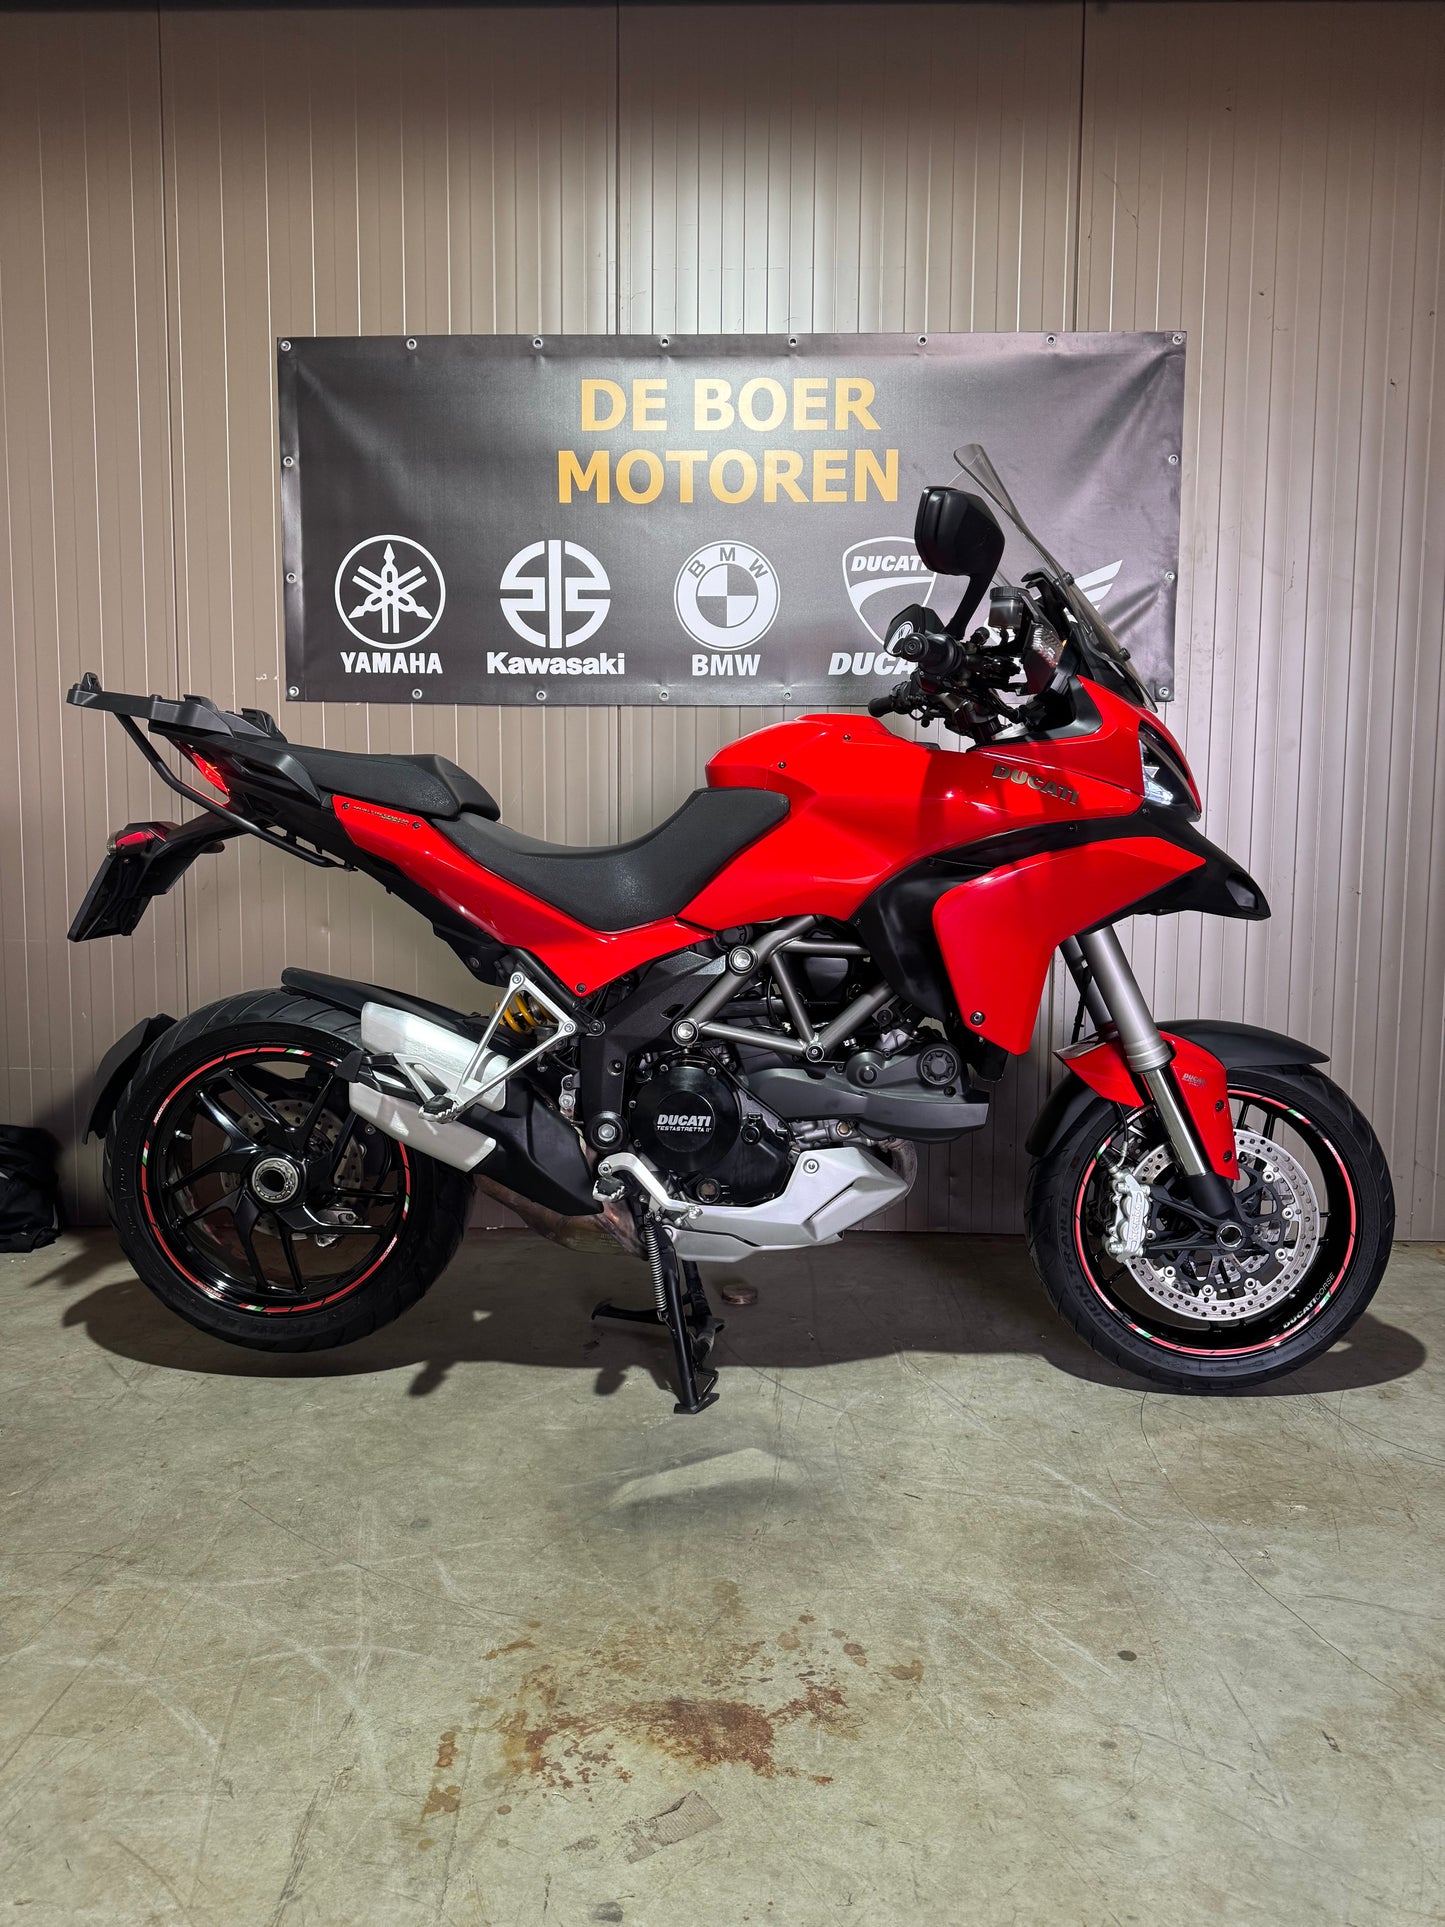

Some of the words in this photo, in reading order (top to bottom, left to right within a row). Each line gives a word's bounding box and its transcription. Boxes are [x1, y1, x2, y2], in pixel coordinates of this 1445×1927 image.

[581, 379, 668, 431] DE
[693, 378, 881, 432] BOER
[558, 449, 899, 504] MOTOREN
[688, 546, 769, 579] BMW
[340, 652, 443, 674] YAMAHA
[486, 651, 625, 676] Kawasaki
[691, 654, 761, 676] BMW
[827, 652, 918, 676] DUCA
[992, 765, 1080, 805] DUCATI
[656, 1114, 712, 1127] DUCATI
